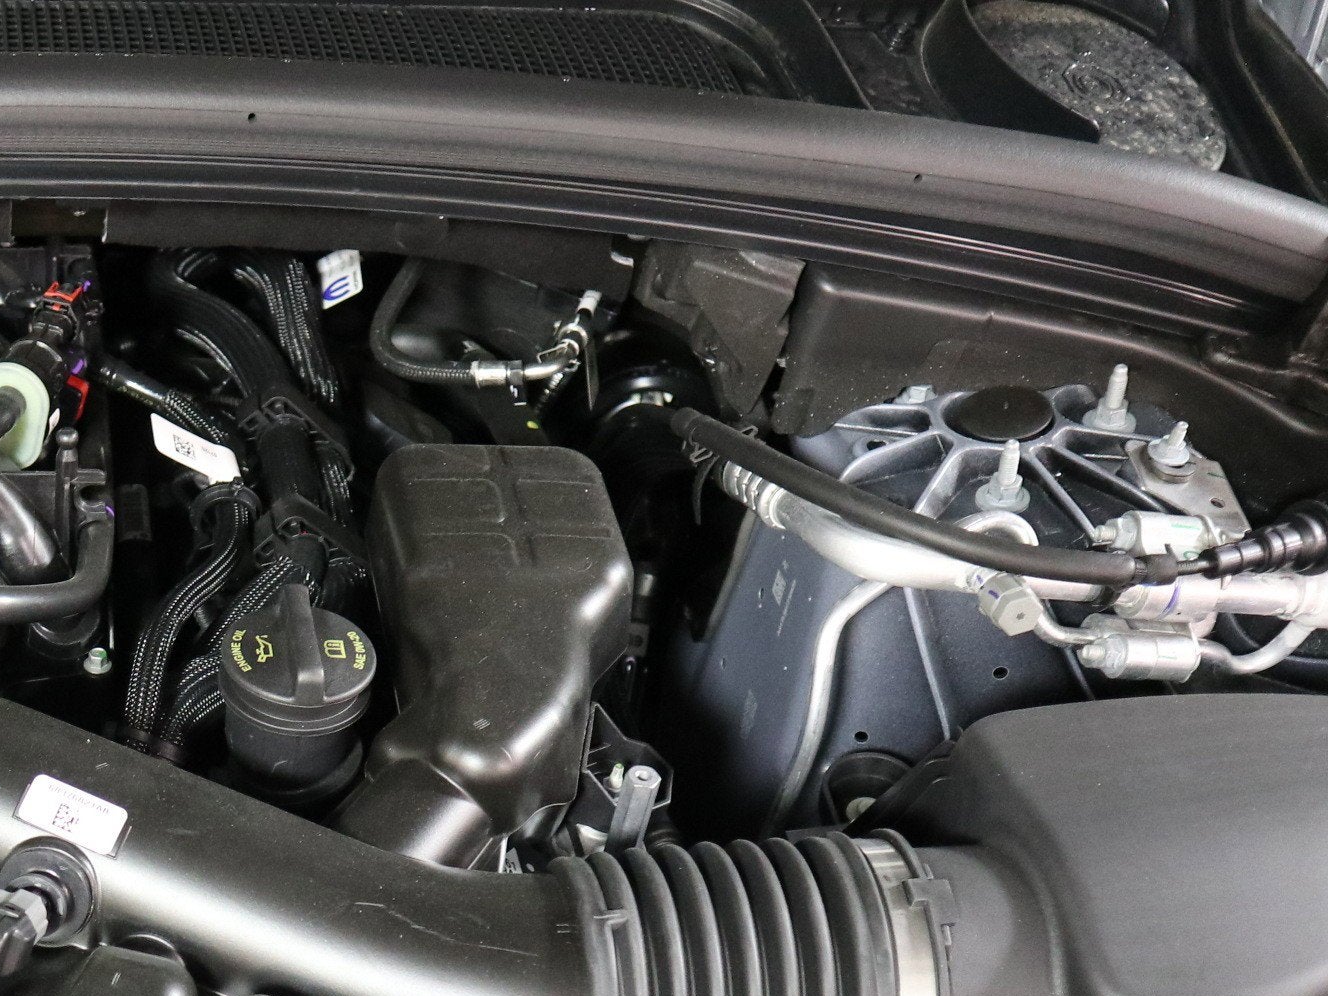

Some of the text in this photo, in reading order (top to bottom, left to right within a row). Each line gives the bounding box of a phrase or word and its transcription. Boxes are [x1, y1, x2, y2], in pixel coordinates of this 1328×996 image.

[231, 629, 252, 673] ENGINE OIL
[346, 631, 367, 670] SAE 0W-20
